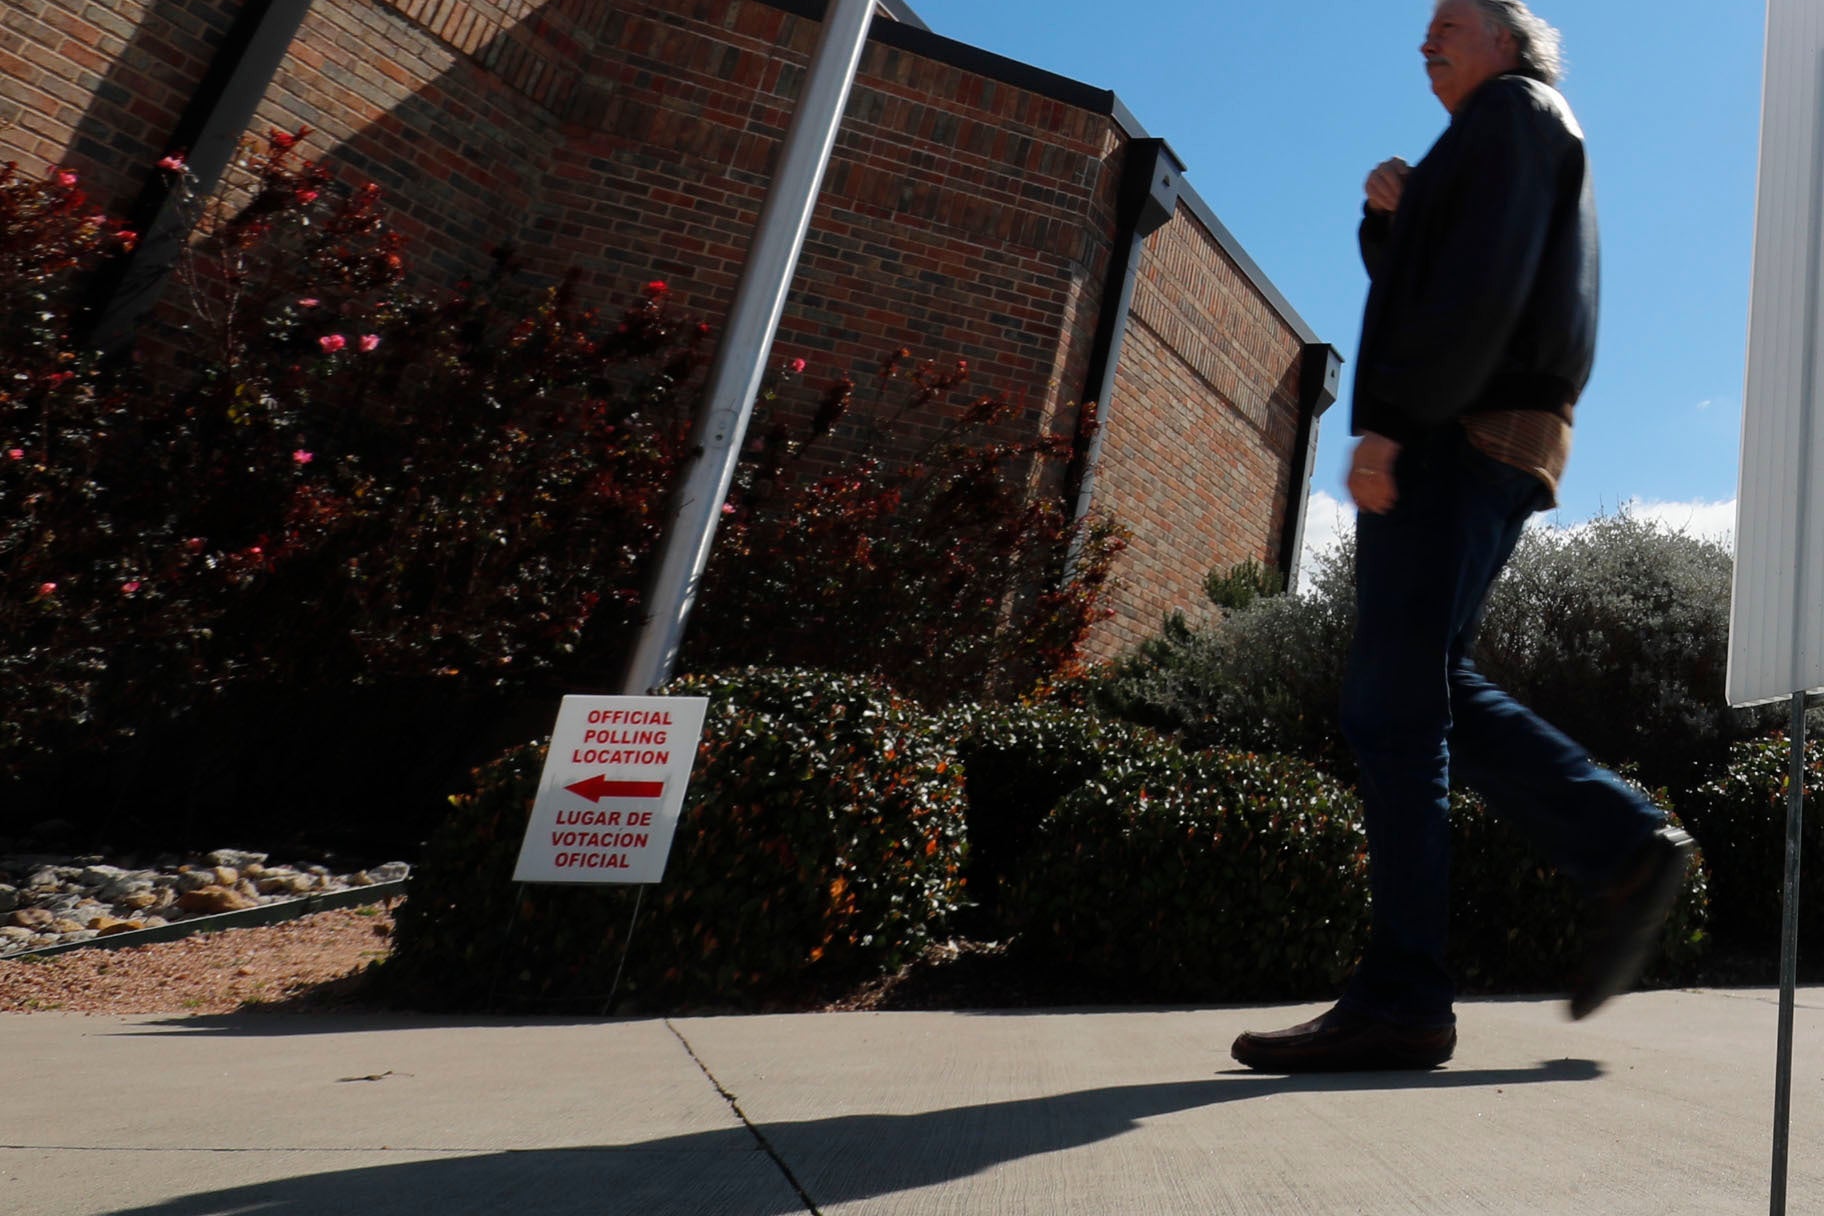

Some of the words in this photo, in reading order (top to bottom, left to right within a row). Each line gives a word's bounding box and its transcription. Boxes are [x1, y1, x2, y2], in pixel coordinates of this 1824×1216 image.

[587, 710, 672, 725] OFFICIAL
[584, 730, 667, 745] POLLING
[572, 749, 670, 764] LOCATION
[556, 810, 620, 825] LUGAR
[626, 812, 653, 826] DE
[555, 853, 630, 868] OFICIAL
